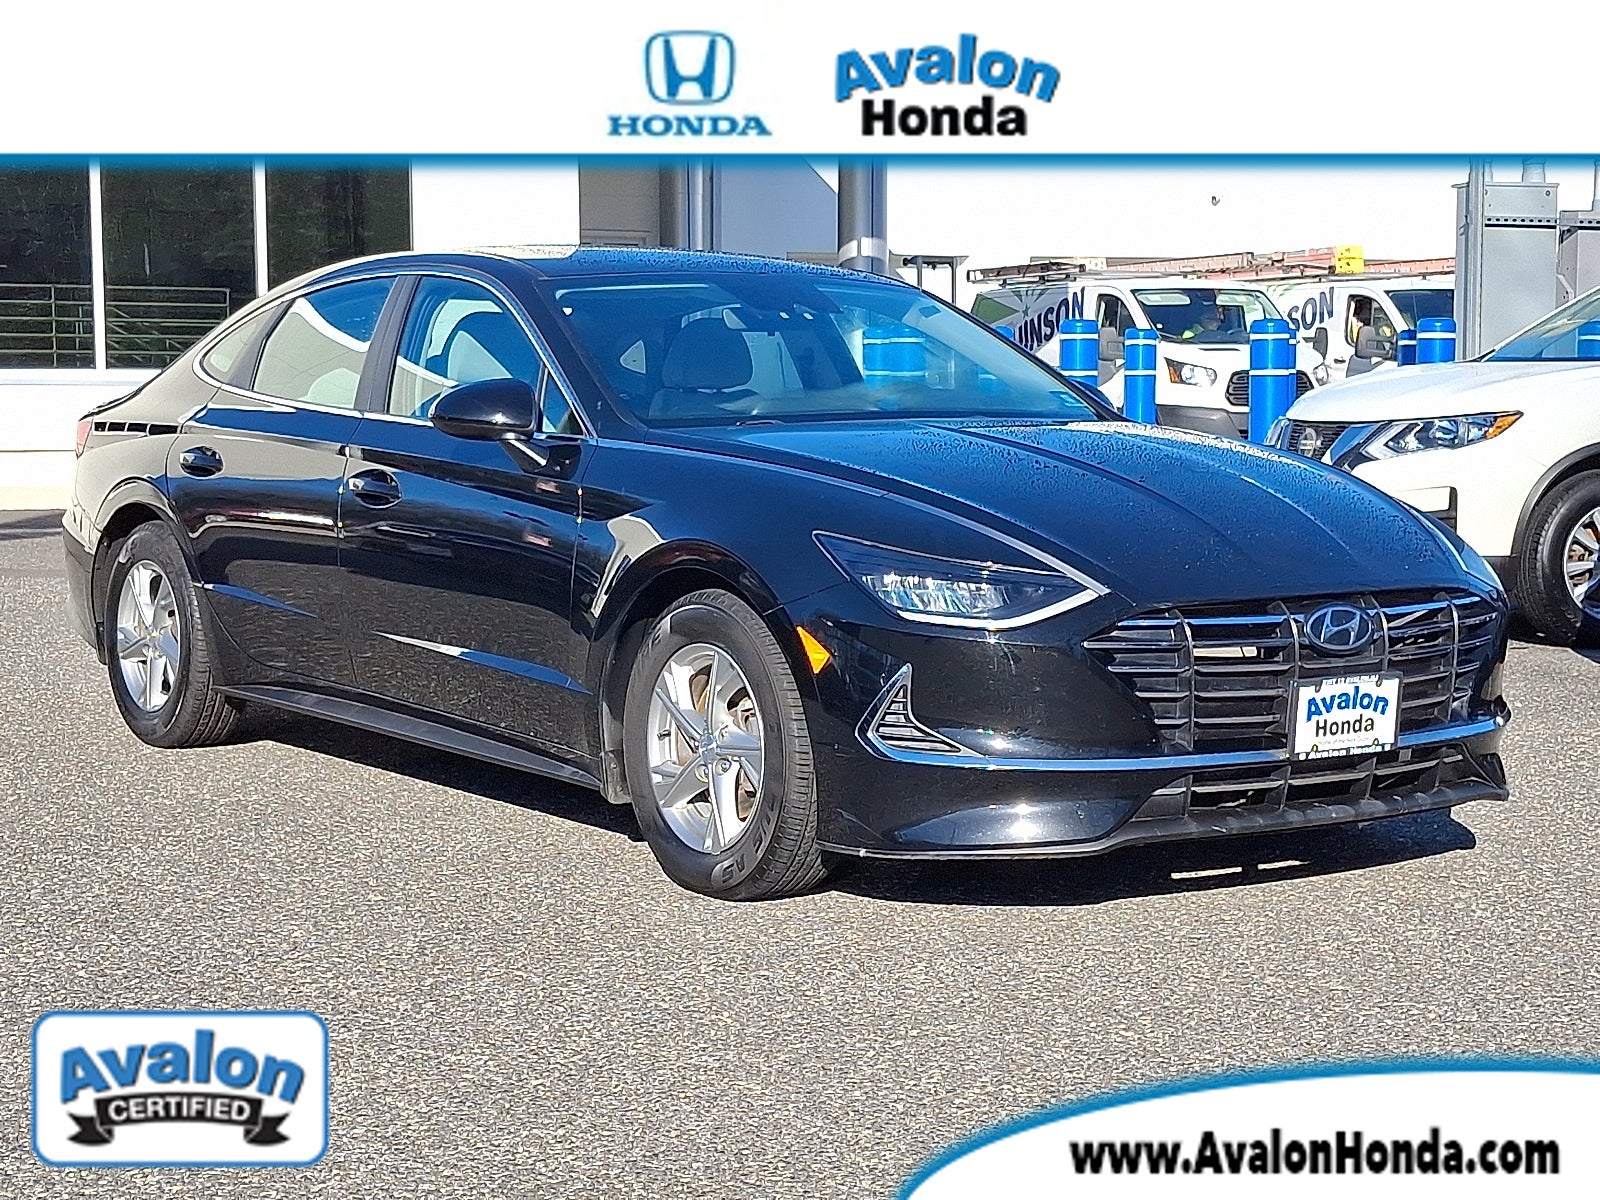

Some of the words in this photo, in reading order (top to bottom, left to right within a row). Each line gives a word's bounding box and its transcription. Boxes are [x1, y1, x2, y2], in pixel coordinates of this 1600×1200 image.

[1013, 286, 1085, 352] INSON
[1306, 685, 1389, 722] Avalon
[1315, 713, 1375, 737] Honda
